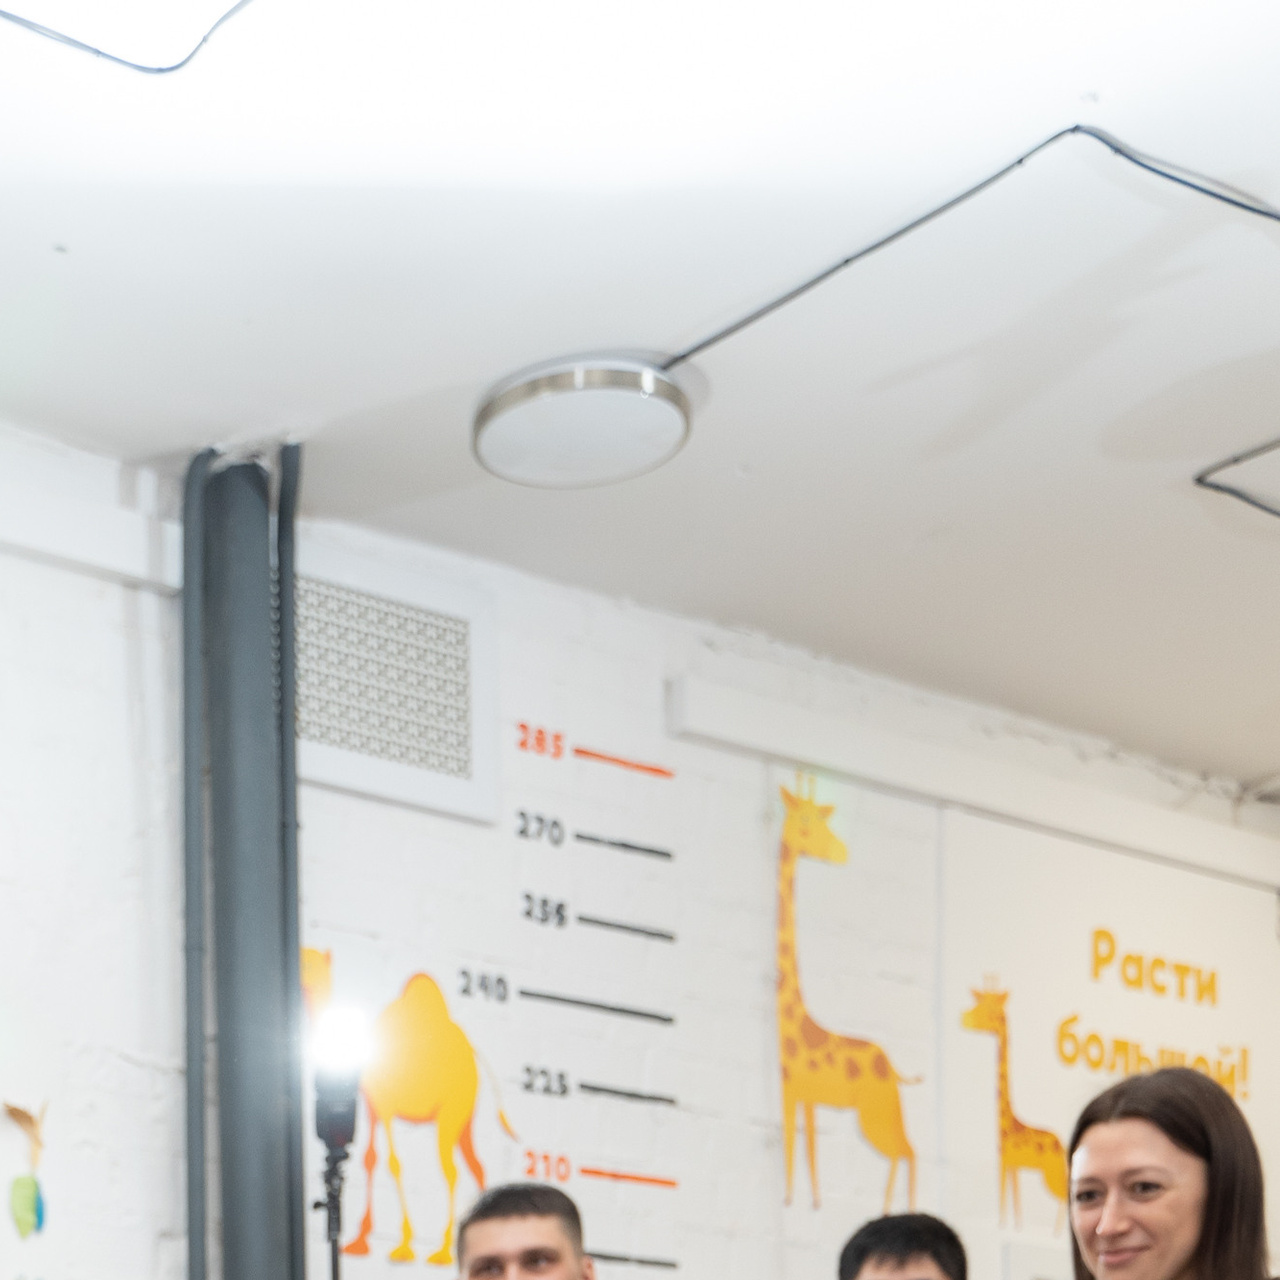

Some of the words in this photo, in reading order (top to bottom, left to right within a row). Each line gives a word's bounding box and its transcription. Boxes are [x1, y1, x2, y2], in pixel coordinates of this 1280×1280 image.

[517, 722, 563, 760] 285
[517, 810, 564, 846] 270
[1091, 928, 1218, 1006] Расти
[460, 969, 508, 1002] 240
[524, 1066, 569, 1096] 225
[524, 1150, 570, 1182] 210
